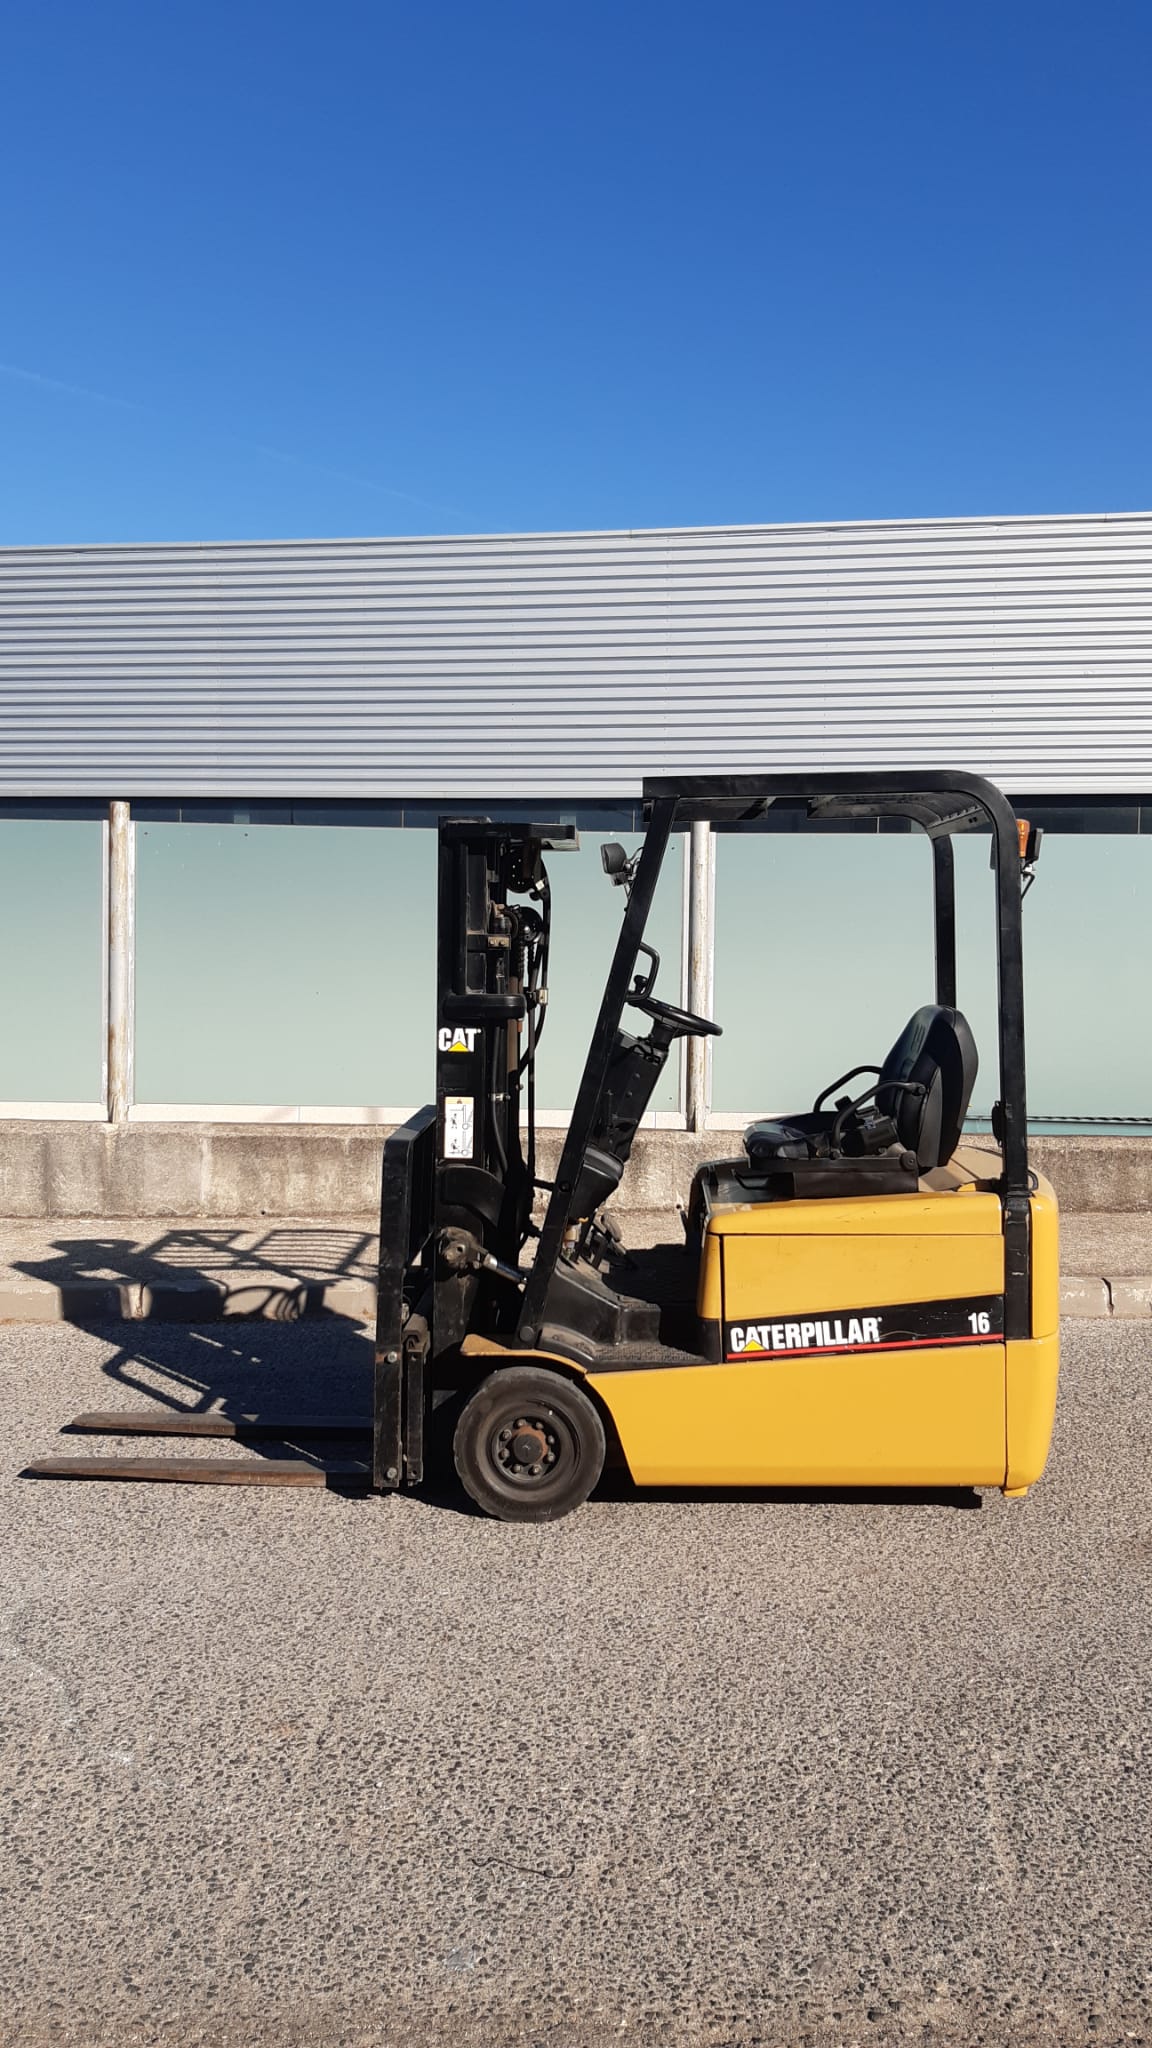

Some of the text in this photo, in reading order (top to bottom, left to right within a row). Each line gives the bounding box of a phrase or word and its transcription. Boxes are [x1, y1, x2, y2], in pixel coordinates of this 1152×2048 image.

[438, 1027, 476, 1053] CAT
[730, 1312, 990, 1352] CATERPILLAR 16
